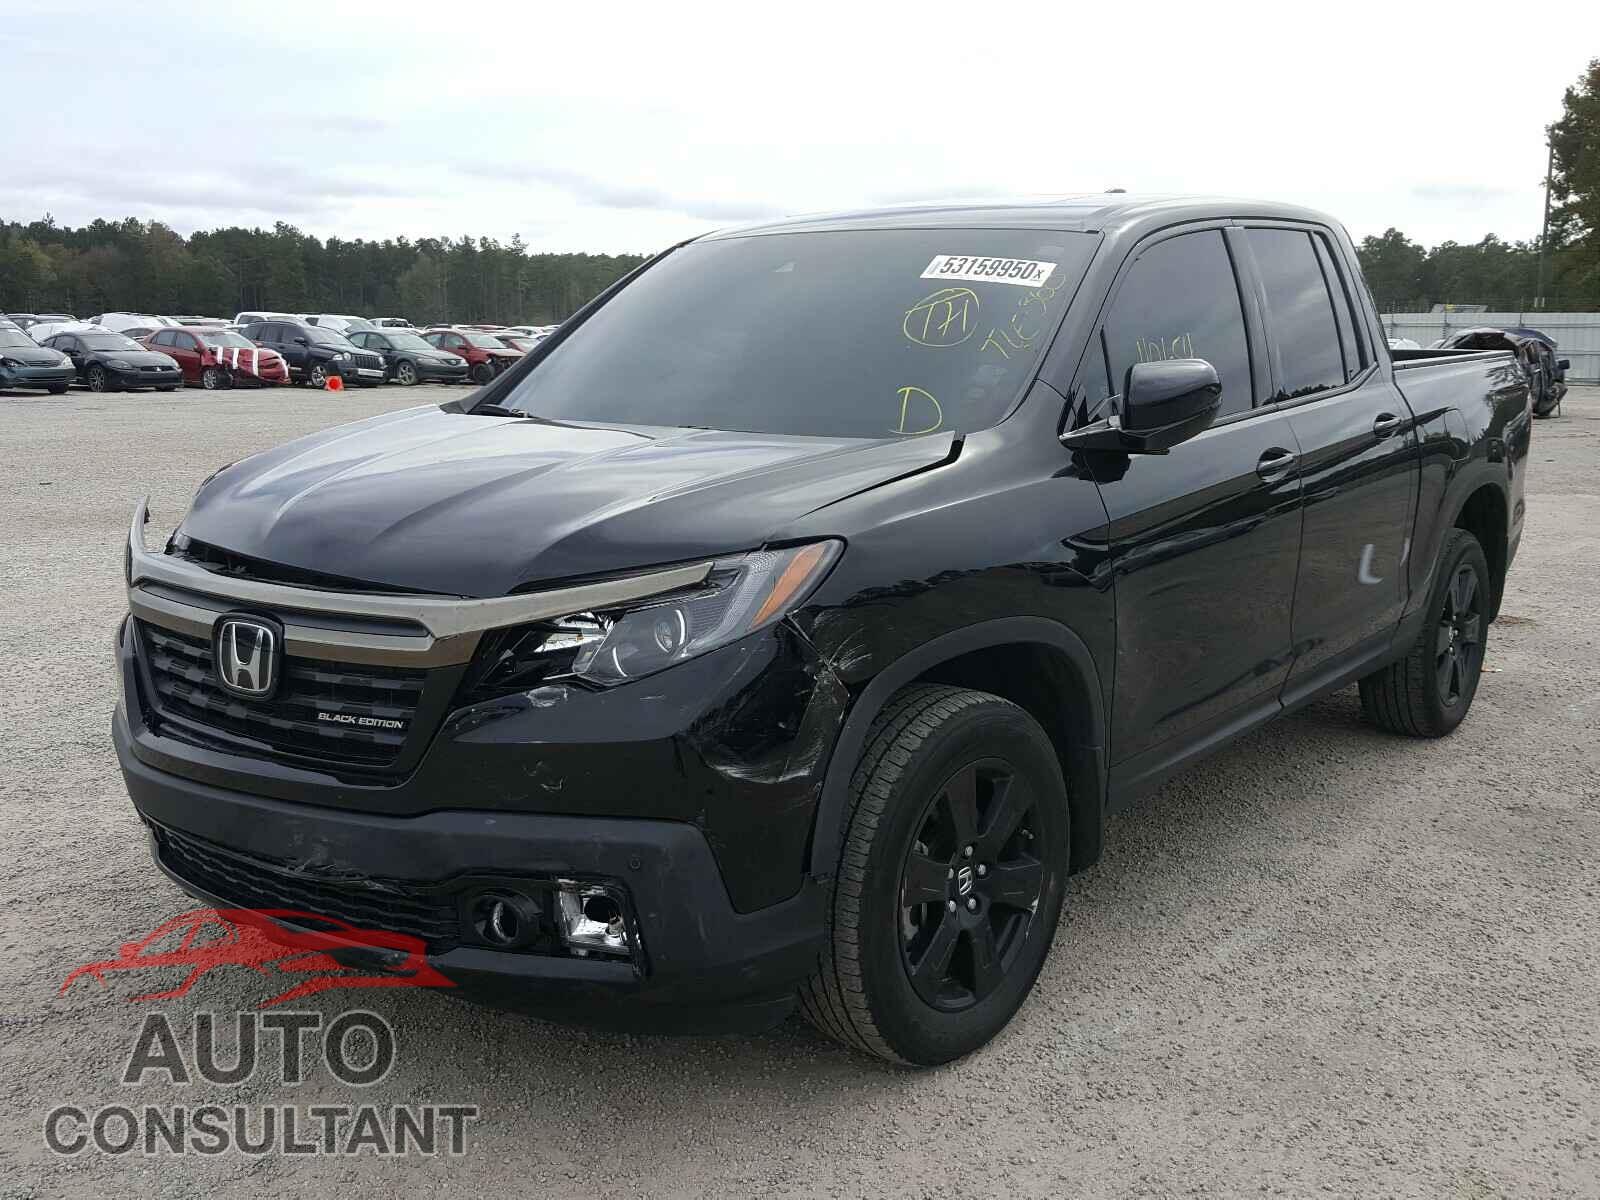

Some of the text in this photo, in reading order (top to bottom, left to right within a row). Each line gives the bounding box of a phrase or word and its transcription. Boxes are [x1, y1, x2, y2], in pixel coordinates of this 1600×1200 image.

[888, 386, 943, 436] D
[317, 711, 404, 729] BLACK EDITION
